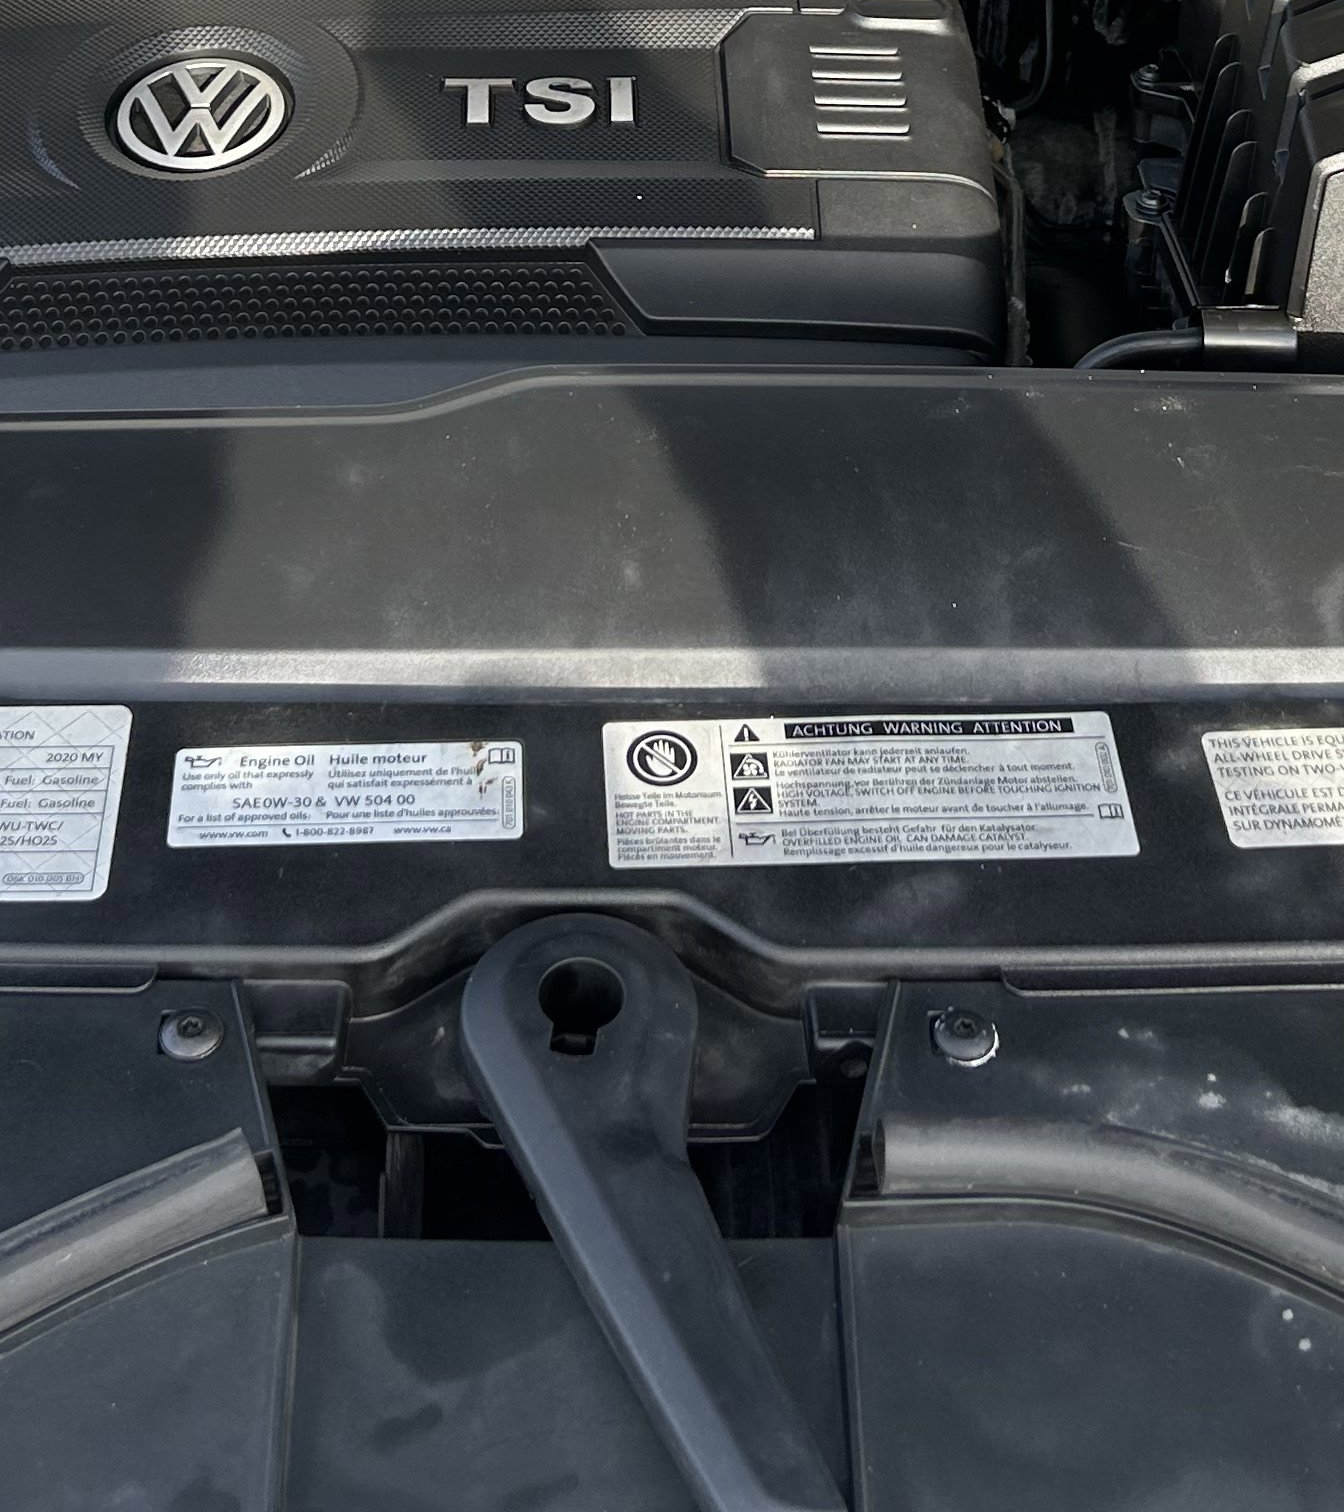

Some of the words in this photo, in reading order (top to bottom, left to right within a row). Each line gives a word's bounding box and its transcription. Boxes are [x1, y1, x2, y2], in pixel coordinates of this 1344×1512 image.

[444, 76, 635, 125] TSI
[792, 722, 873, 737] ACHTUNG
[883, 721, 963, 734] WARNING
[973, 720, 1062, 733] ATTENTION
[1208, 738, 1240, 749] THIS
[1242, 736, 1297, 748] VEHICLE
[1302, 736, 1313, 746] IS
[46, 753, 77, 762] 2020
[81, 753, 103, 762] MY
[240, 755, 290, 769] Engine
[294, 755, 315, 767] Oil
[329, 754, 368, 765] Huile
[373, 753, 427, 764] moteur
[1214, 751, 1290, 764] ALL-WHEEL
[1292, 749, 1331, 761] DRIVE
[204, 771, 225, 781] only
[228, 771, 240, 779] oil
[243, 770, 264, 779] that
[266, 769, 314, 780] expressly
[328, 769, 366, 778] Utilisez
[370, 768, 432, 778] uniquement
[436, 767, 448, 776] de
[1217, 766, 1274, 779] TESTING
[1278, 765, 1300, 776] ON
[5, 775, 35, 785] Fuel:
[42, 775, 99, 785] Gasoline
[181, 782, 227, 792] complies
[230, 781, 253, 790] with
[327, 780, 345, 790] qui
[347, 779, 388, 788] satisfait
[391, 778, 463, 788] expressément
[466, 777, 473, 786] à
[1225, 790, 1240, 801] CE
[1245, 785, 1309, 799] VÉHICULE
[1312, 787, 1334, 798] EST
[0, 798, 32, 808] Fuel:
[38, 798, 95, 808] Gasoline
[315, 796, 326, 807] &
[334, 795, 360, 807] VW
[365, 795, 392, 805] 504
[396, 794, 415, 805] 00
[326, 811, 349, 819] Pour
[352, 811, 371, 819] une
[374, 809, 395, 818] liste
[397, 808, 435, 818] d'huiles
[779, 808, 811, 817] Haute
[814, 807, 853, 816] tension,
[892, 805, 900, 814] le
[903, 805, 939, 813] moteur
[942, 804, 969, 813] avant
[972, 803, 983, 812] de
[987, 802, 1024, 812] toucher
[1229, 801, 1300, 816] INTÉGRALE
[178, 814, 195, 823] For
[206, 813, 222, 822] list
[224, 813, 235, 821] of
[238, 812, 287, 823] approved
[290, 812, 311, 820] oils:
[1233, 820, 1261, 831] SUR
[199, 830, 268, 839] www.vw.com
[393, 826, 452, 834] www.vw.ca
